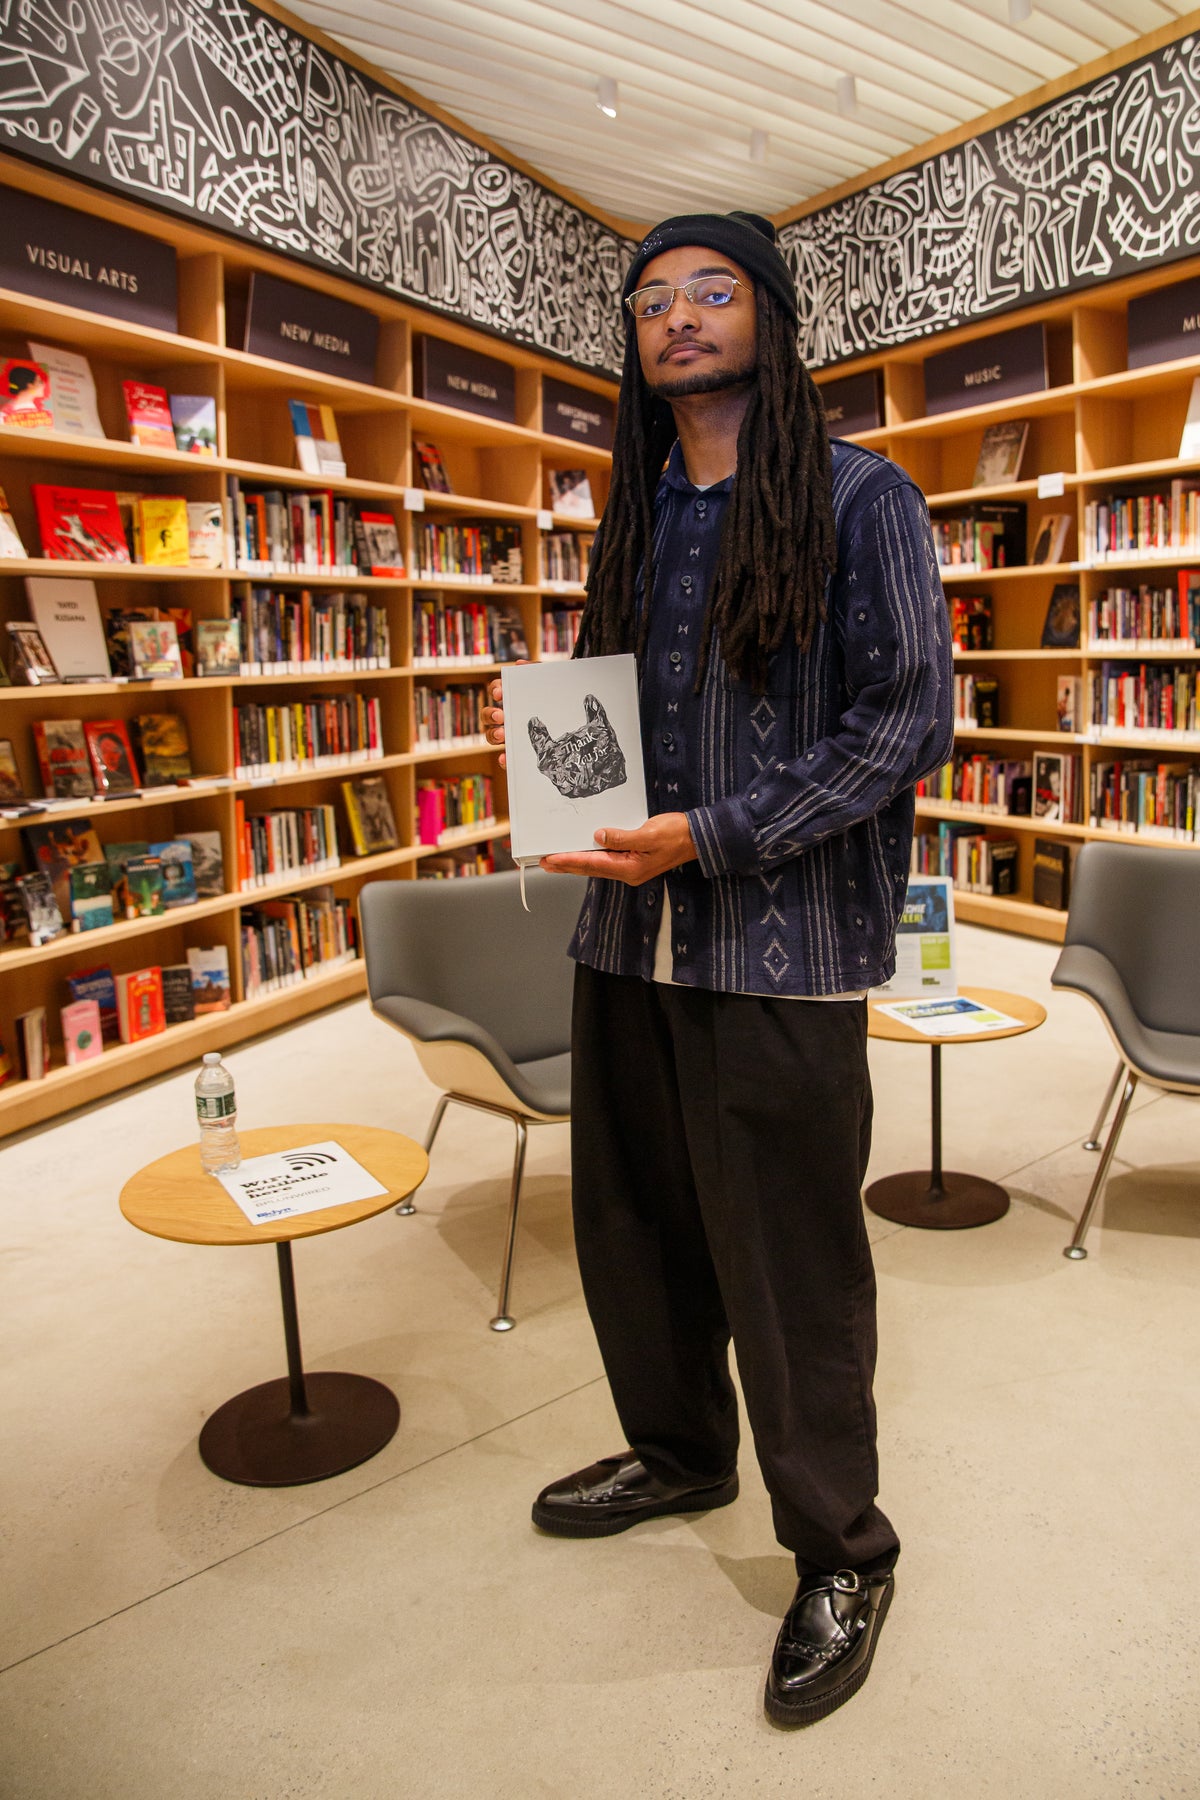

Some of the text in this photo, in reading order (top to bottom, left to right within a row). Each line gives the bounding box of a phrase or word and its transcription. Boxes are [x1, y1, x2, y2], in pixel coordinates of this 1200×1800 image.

[862, 203, 904, 235] READ
[26, 243, 139, 293] VISUAL ARTS
[281, 320, 351, 355] NEW MEDIA
[447, 374, 499, 399] NEW MEDIA
[963, 365, 1001, 387] MUSIC
[561, 731, 599, 754] Thank
[565, 745, 609, 768] You for
[239, 1174, 293, 1188] WiFi
[245, 1172, 329, 1194] available
[248, 1186, 293, 1200] here
